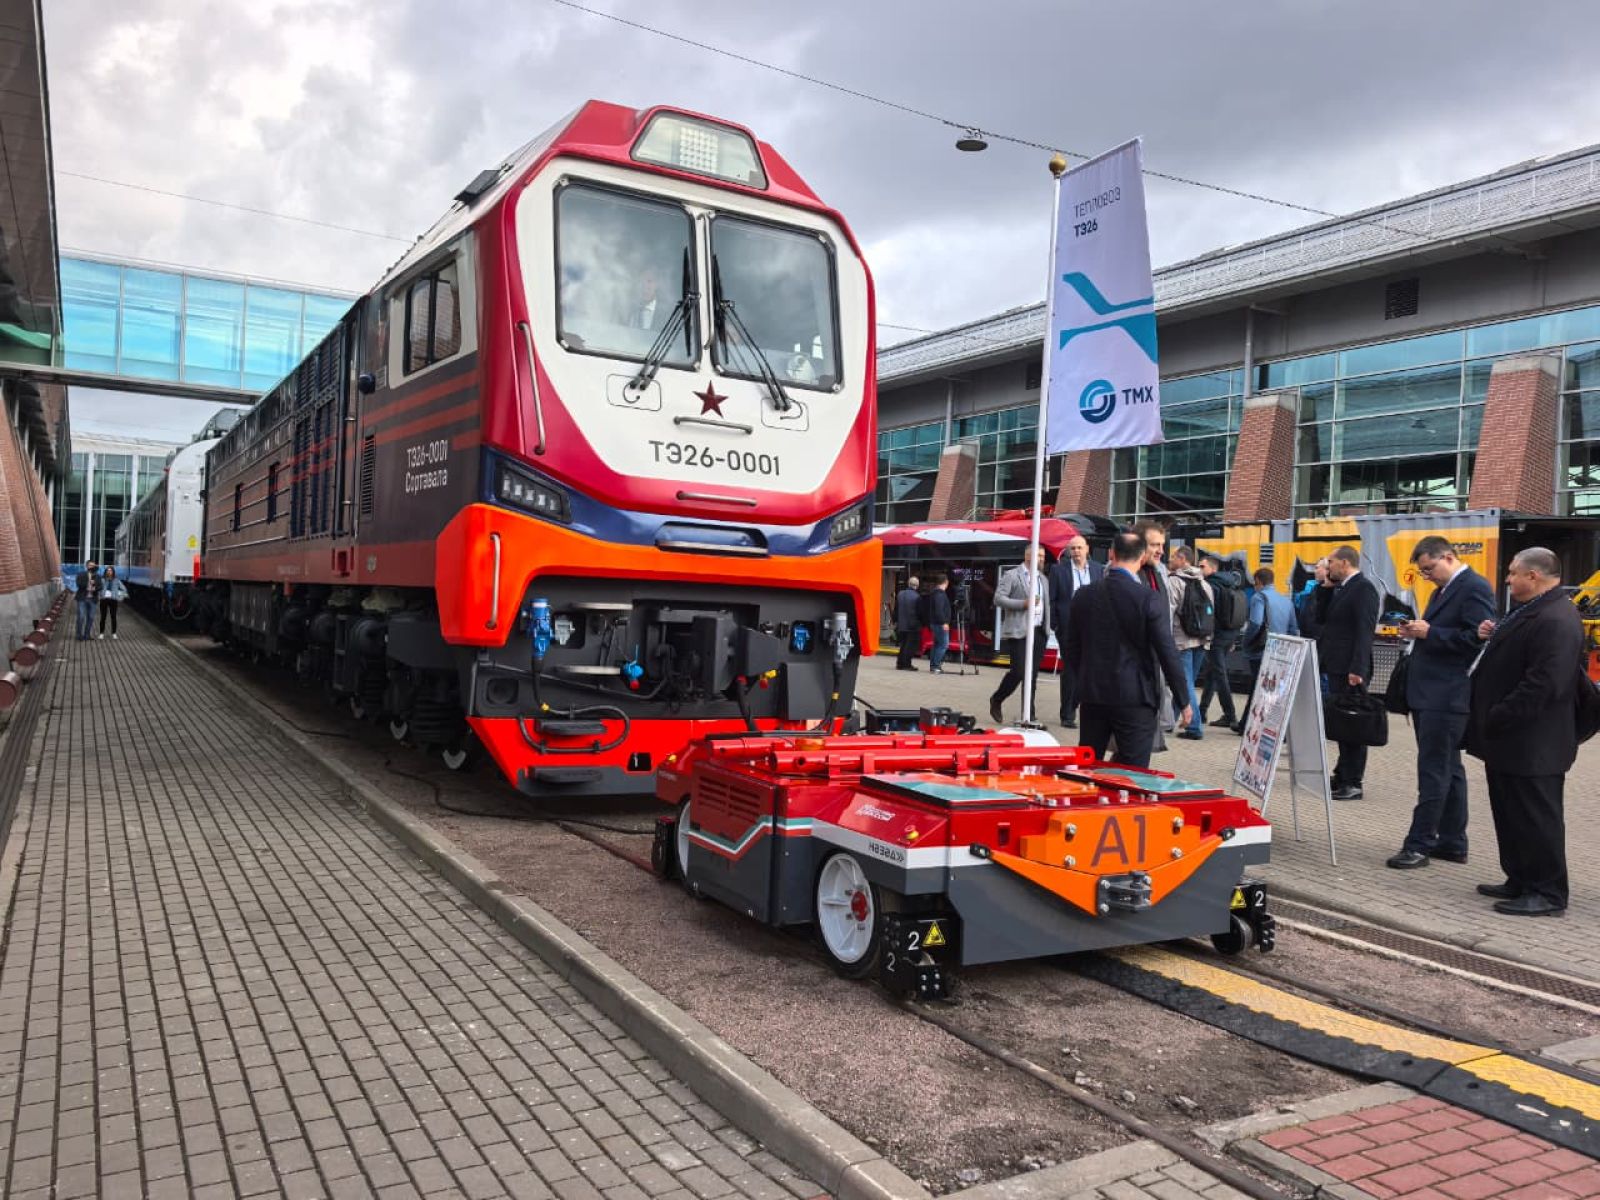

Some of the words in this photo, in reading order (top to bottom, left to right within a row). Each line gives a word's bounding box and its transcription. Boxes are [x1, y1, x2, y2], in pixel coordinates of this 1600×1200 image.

[1074, 186, 1121, 218] ТЕПЛОВОЗ
[1073, 219, 1098, 238] ТЭ26
[405, 439, 448, 468] ТЭ26-0001
[648, 439, 780, 476] ТЭ26-0001
[405, 469, 448, 495] Сортавала
[1254, 890, 1265, 907] 2
[908, 930, 920, 951] 2
[886, 951, 896, 972] 2
